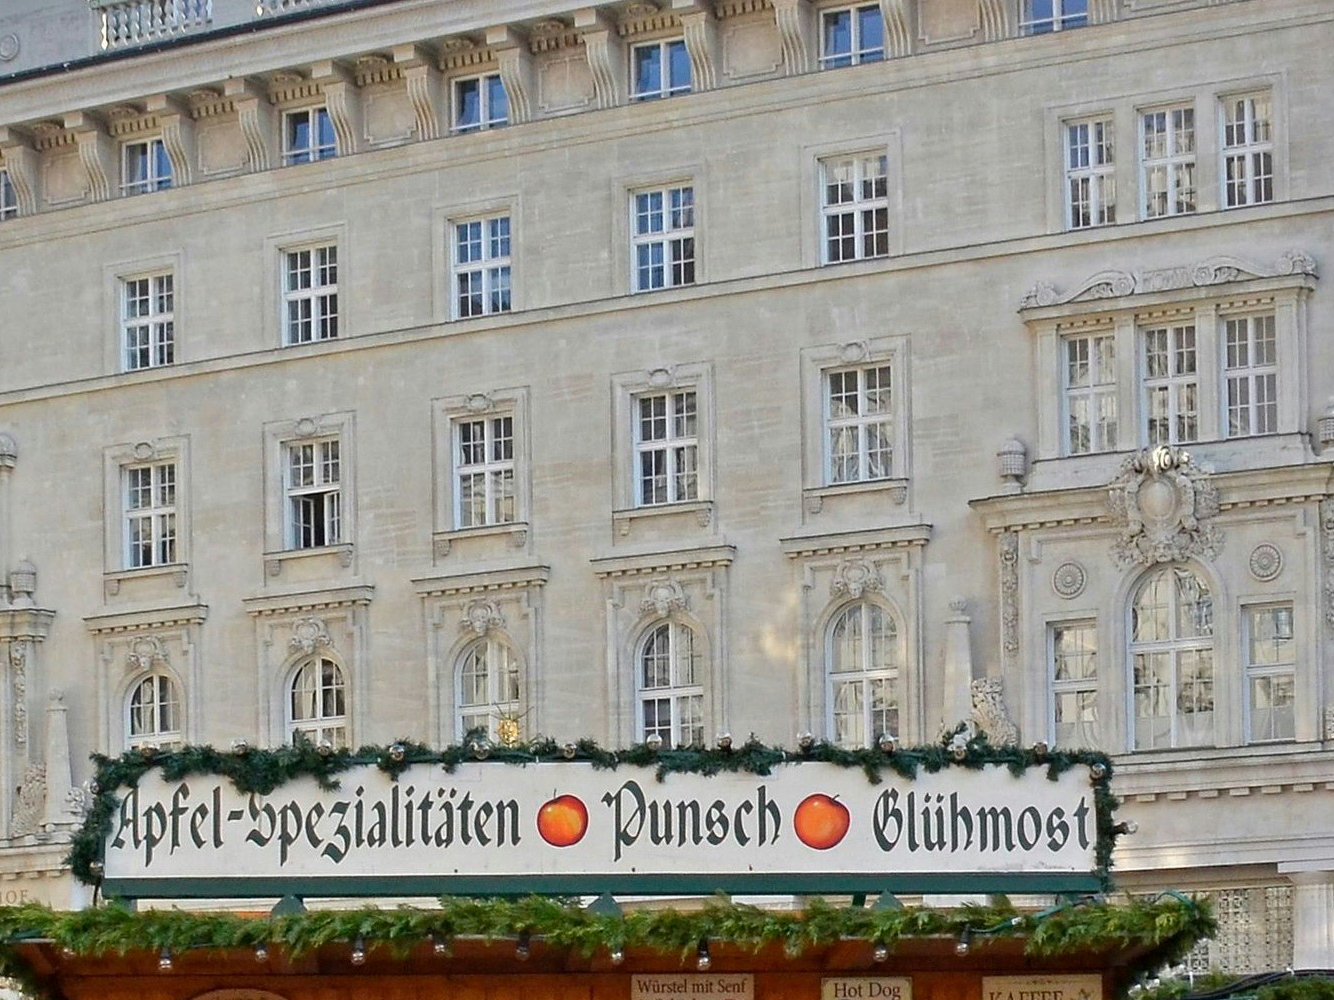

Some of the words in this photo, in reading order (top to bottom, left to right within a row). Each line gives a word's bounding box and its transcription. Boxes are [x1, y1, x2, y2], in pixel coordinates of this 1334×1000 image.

[110, 782, 522, 868] Apfel-Spezialitäten
[601, 780, 782, 863] Punsch
[872, 787, 1091, 853] Glühmost
[636, 979, 687, 994] Würstel
[692, 979, 713, 993] mit
[717, 978, 750, 993] Senf
[834, 982, 863, 998] Hot
